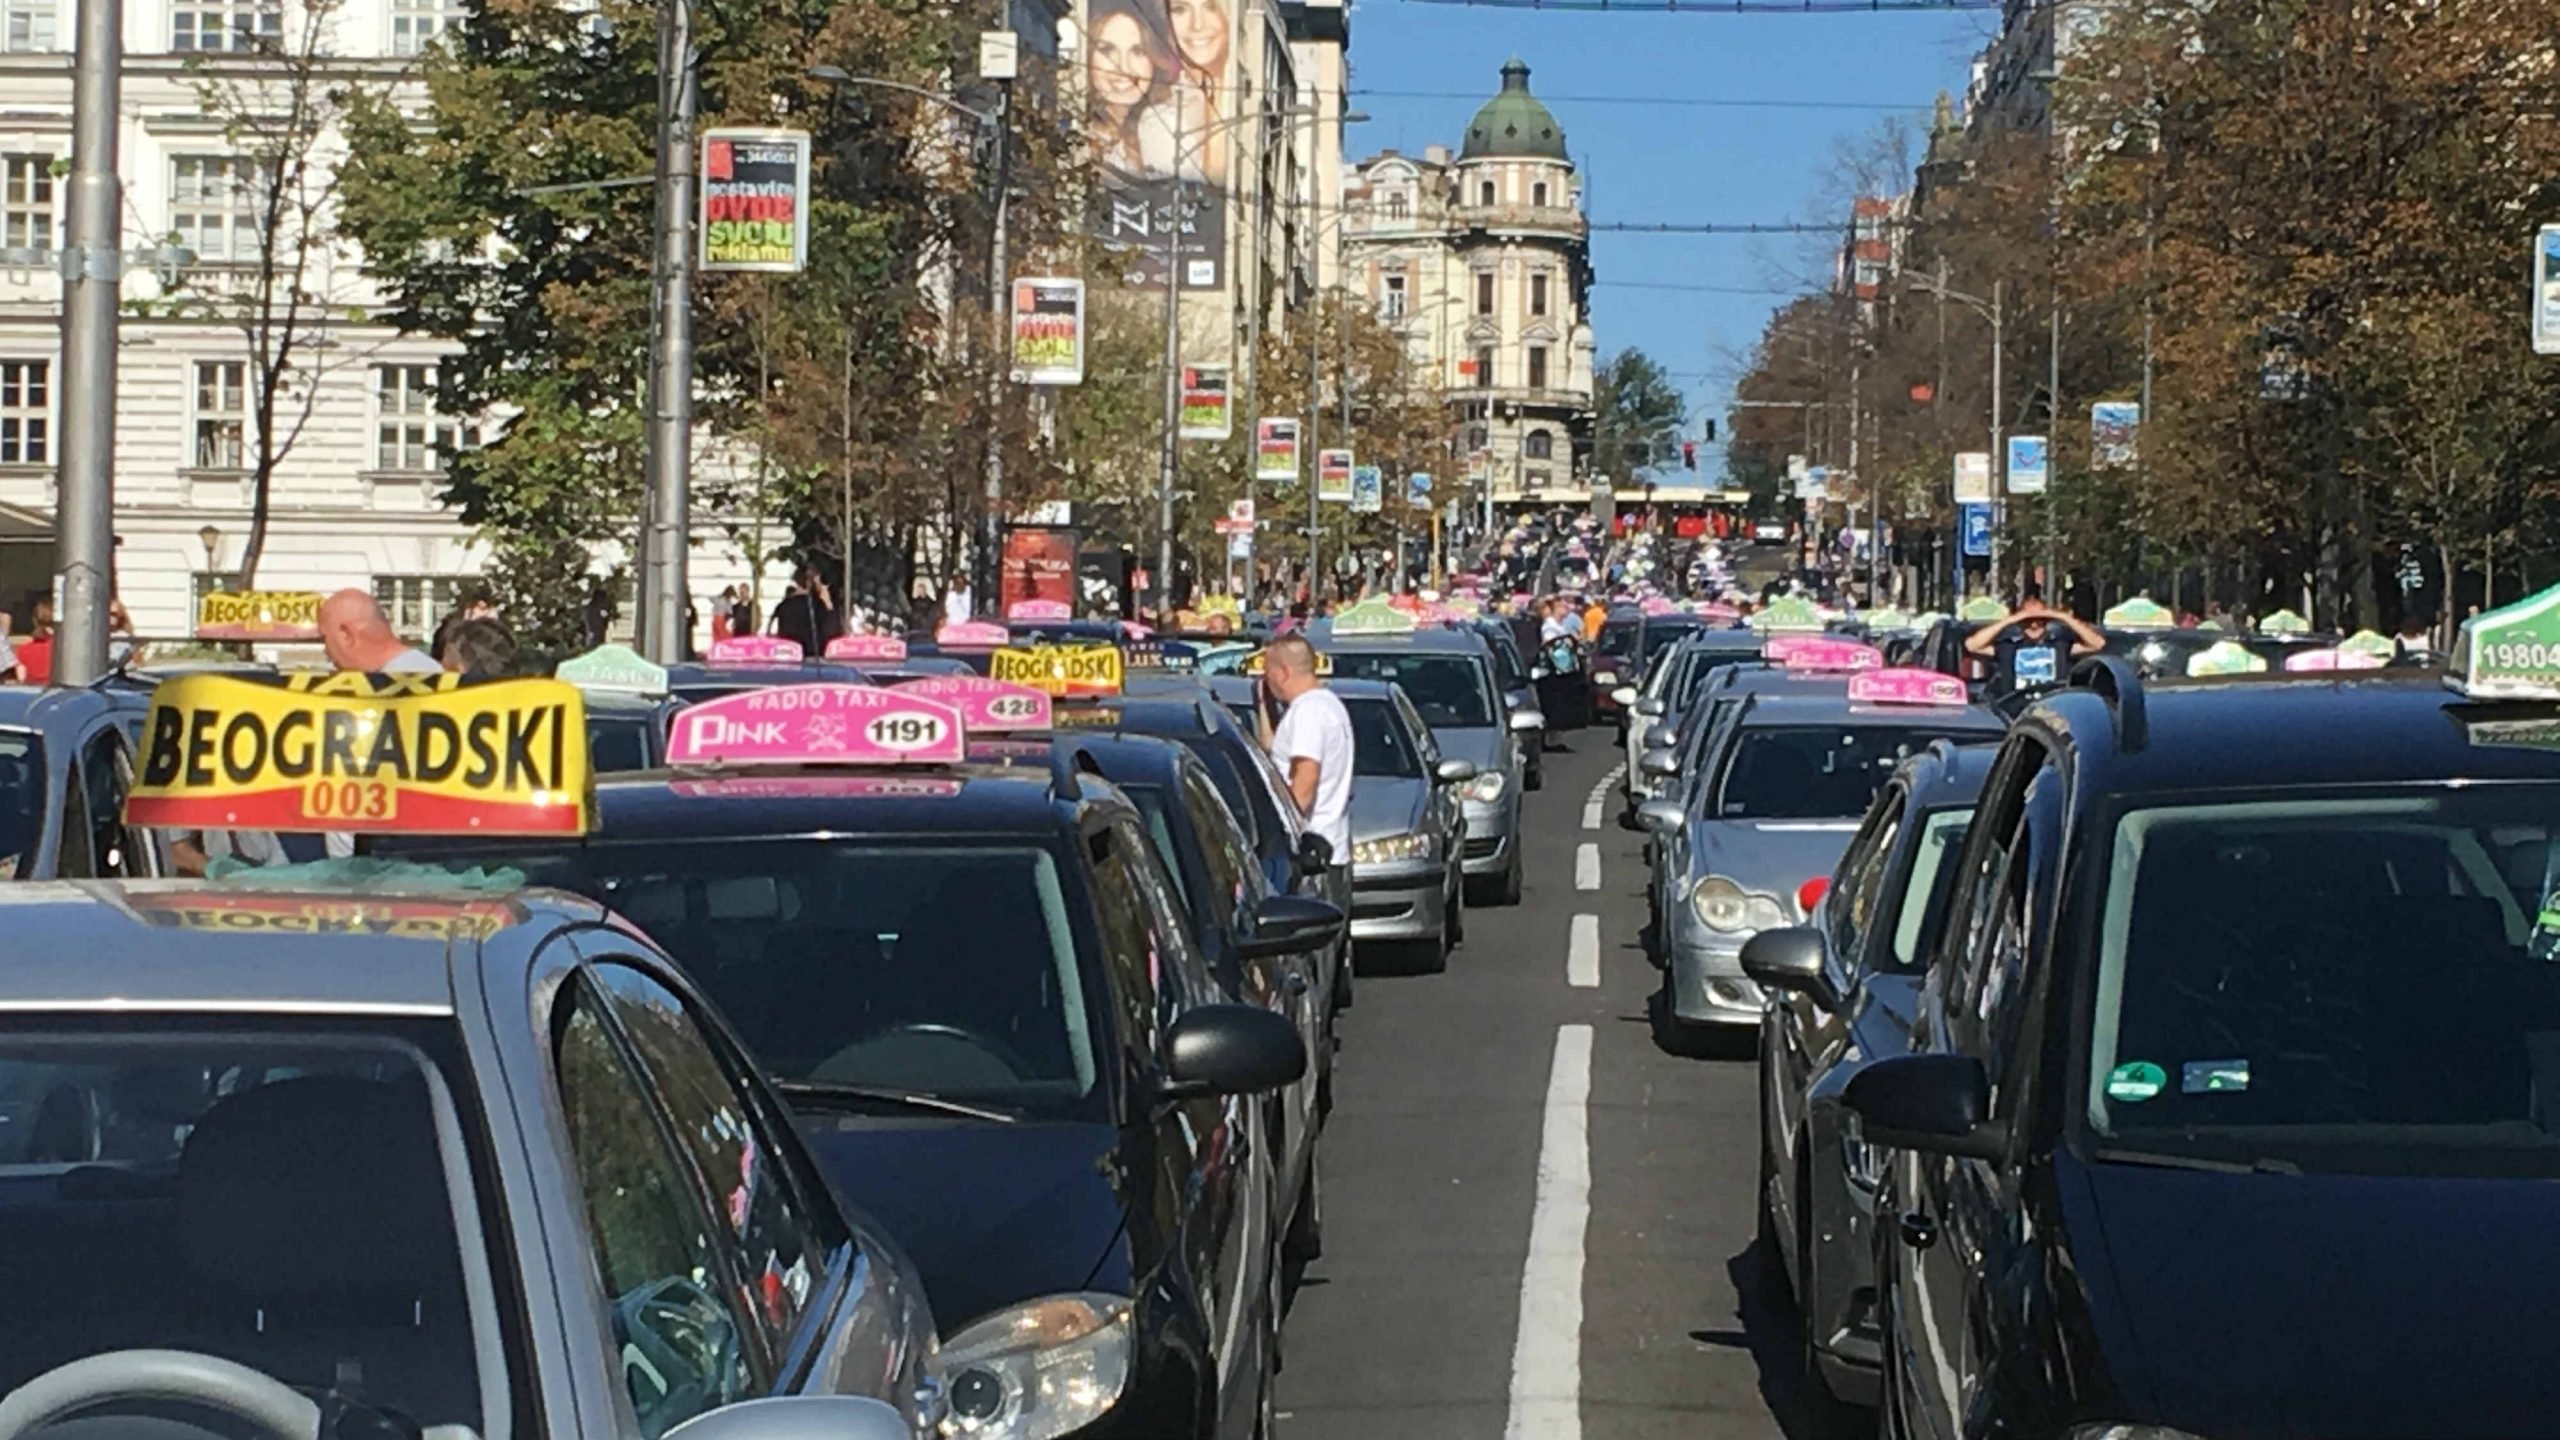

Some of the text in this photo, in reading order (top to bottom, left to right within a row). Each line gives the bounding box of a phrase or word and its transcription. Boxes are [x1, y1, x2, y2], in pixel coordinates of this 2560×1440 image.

[1358, 615, 1393, 625] TAXI
[2483, 642, 2560, 670] 19804
[908, 678, 1004, 695] RADIO TAXI
[748, 689, 889, 712] RADIO TAXI
[991, 698, 1039, 717] 428
[870, 719, 938, 743] 1191
[142, 704, 567, 792] BEOGRADSKI
[310, 780, 389, 818] 003
